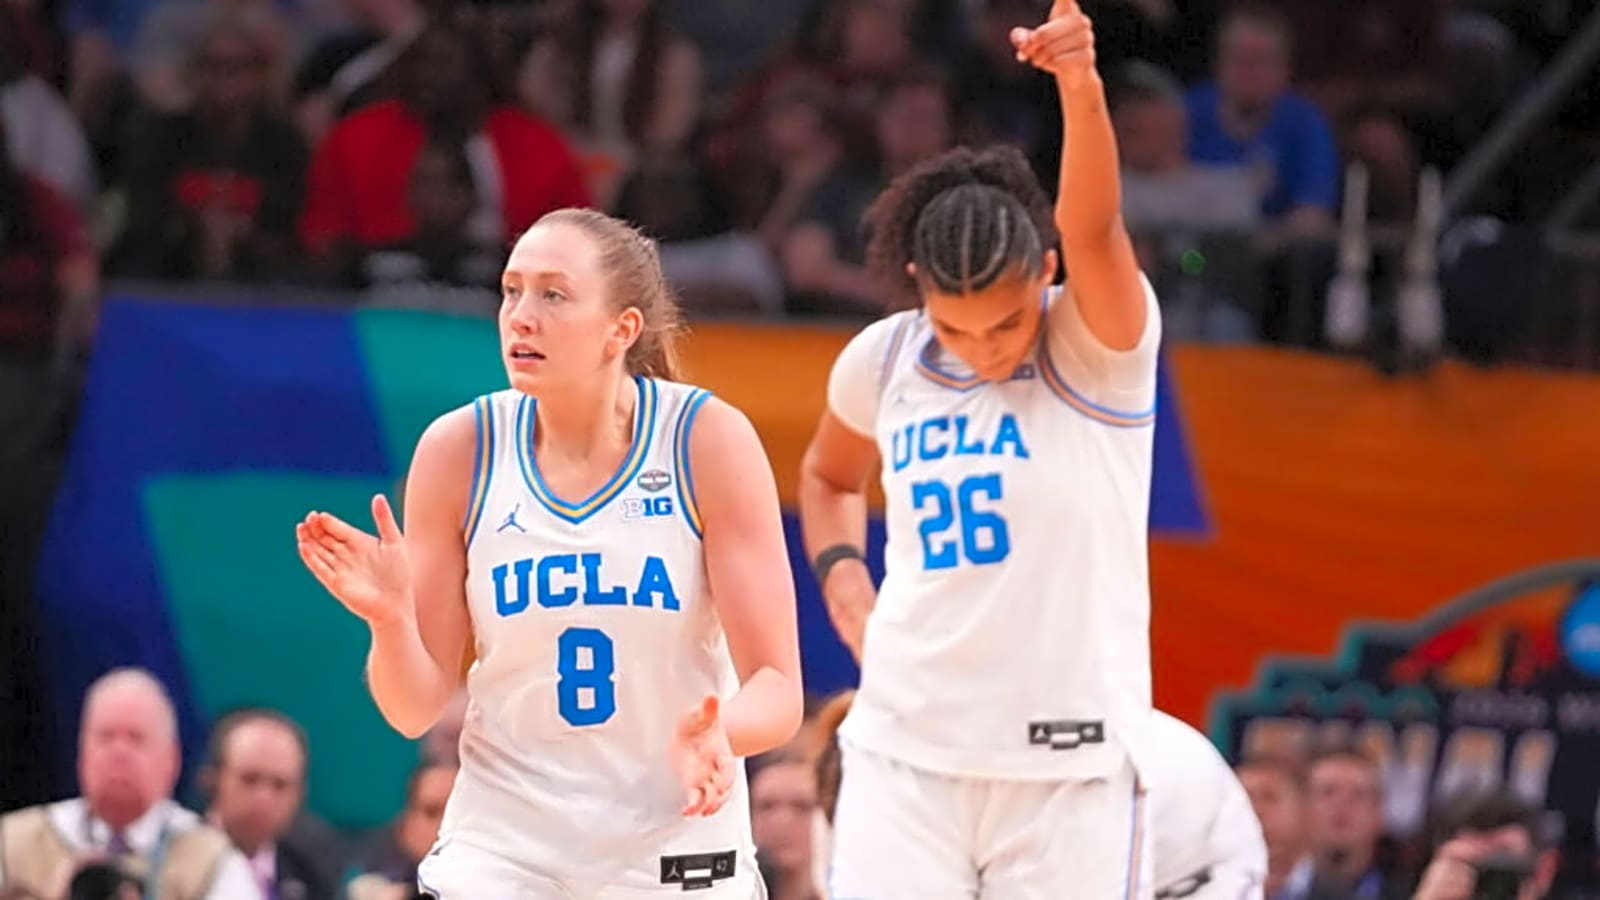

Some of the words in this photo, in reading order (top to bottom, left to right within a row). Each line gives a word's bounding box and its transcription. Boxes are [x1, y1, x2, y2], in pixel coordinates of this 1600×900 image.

[891, 412, 1030, 472] UCLA
[911, 473, 1011, 571] 26
[491, 553, 681, 617] UCLA
[556, 626, 617, 727] 8
